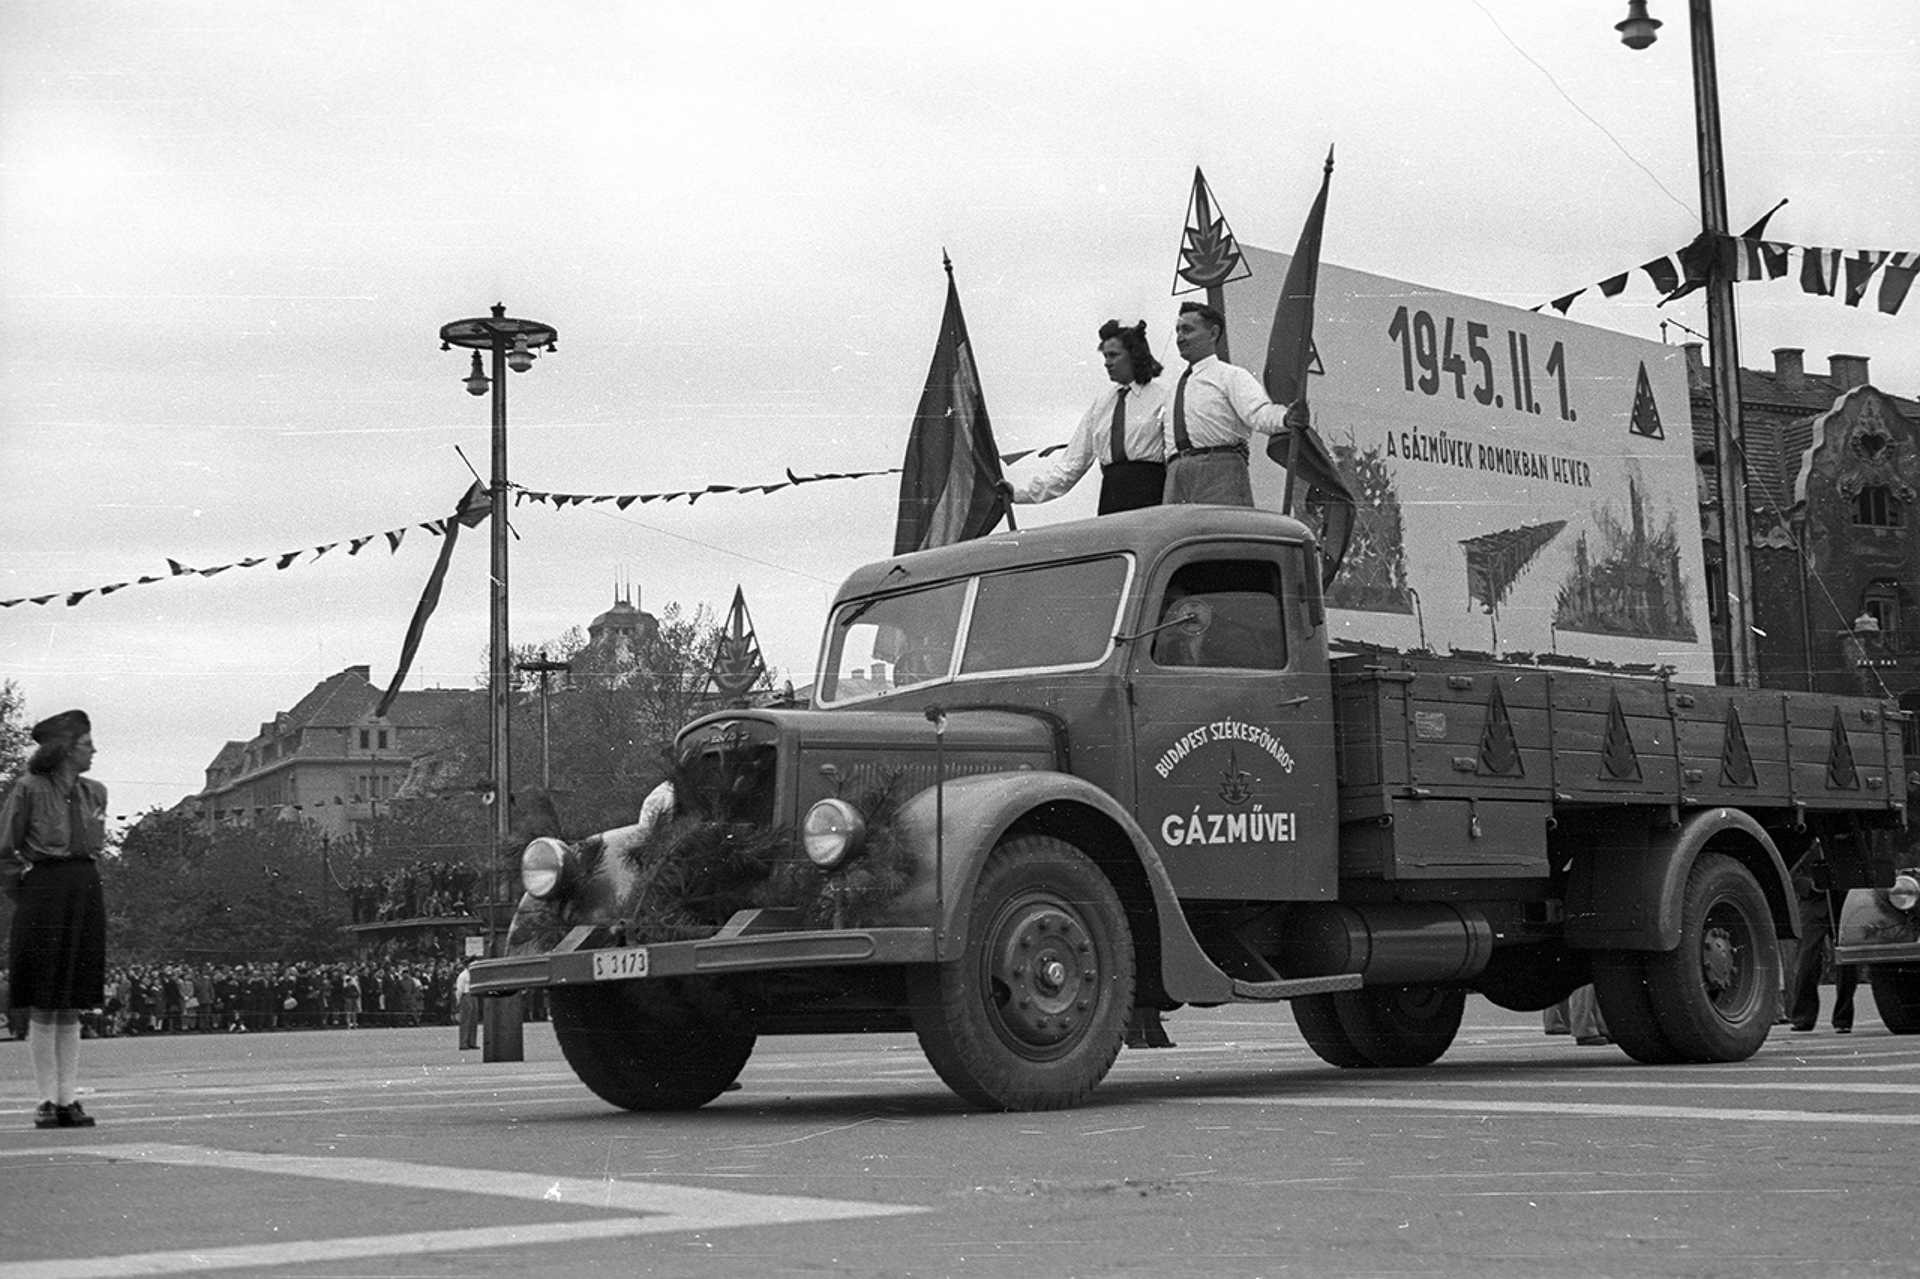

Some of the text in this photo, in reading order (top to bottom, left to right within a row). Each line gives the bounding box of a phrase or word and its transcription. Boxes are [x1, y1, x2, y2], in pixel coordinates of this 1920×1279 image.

[1387, 430, 1397, 457] A
[1478, 443, 1549, 481] ROMOKBAN
[1552, 456, 1592, 488] HEVER
[1155, 715, 1295, 779] BUDAPEST SZÉKESFŐVÁROS
[1161, 804, 1296, 847] GÁZMŰVEI
[612, 953, 645, 974] 3173
